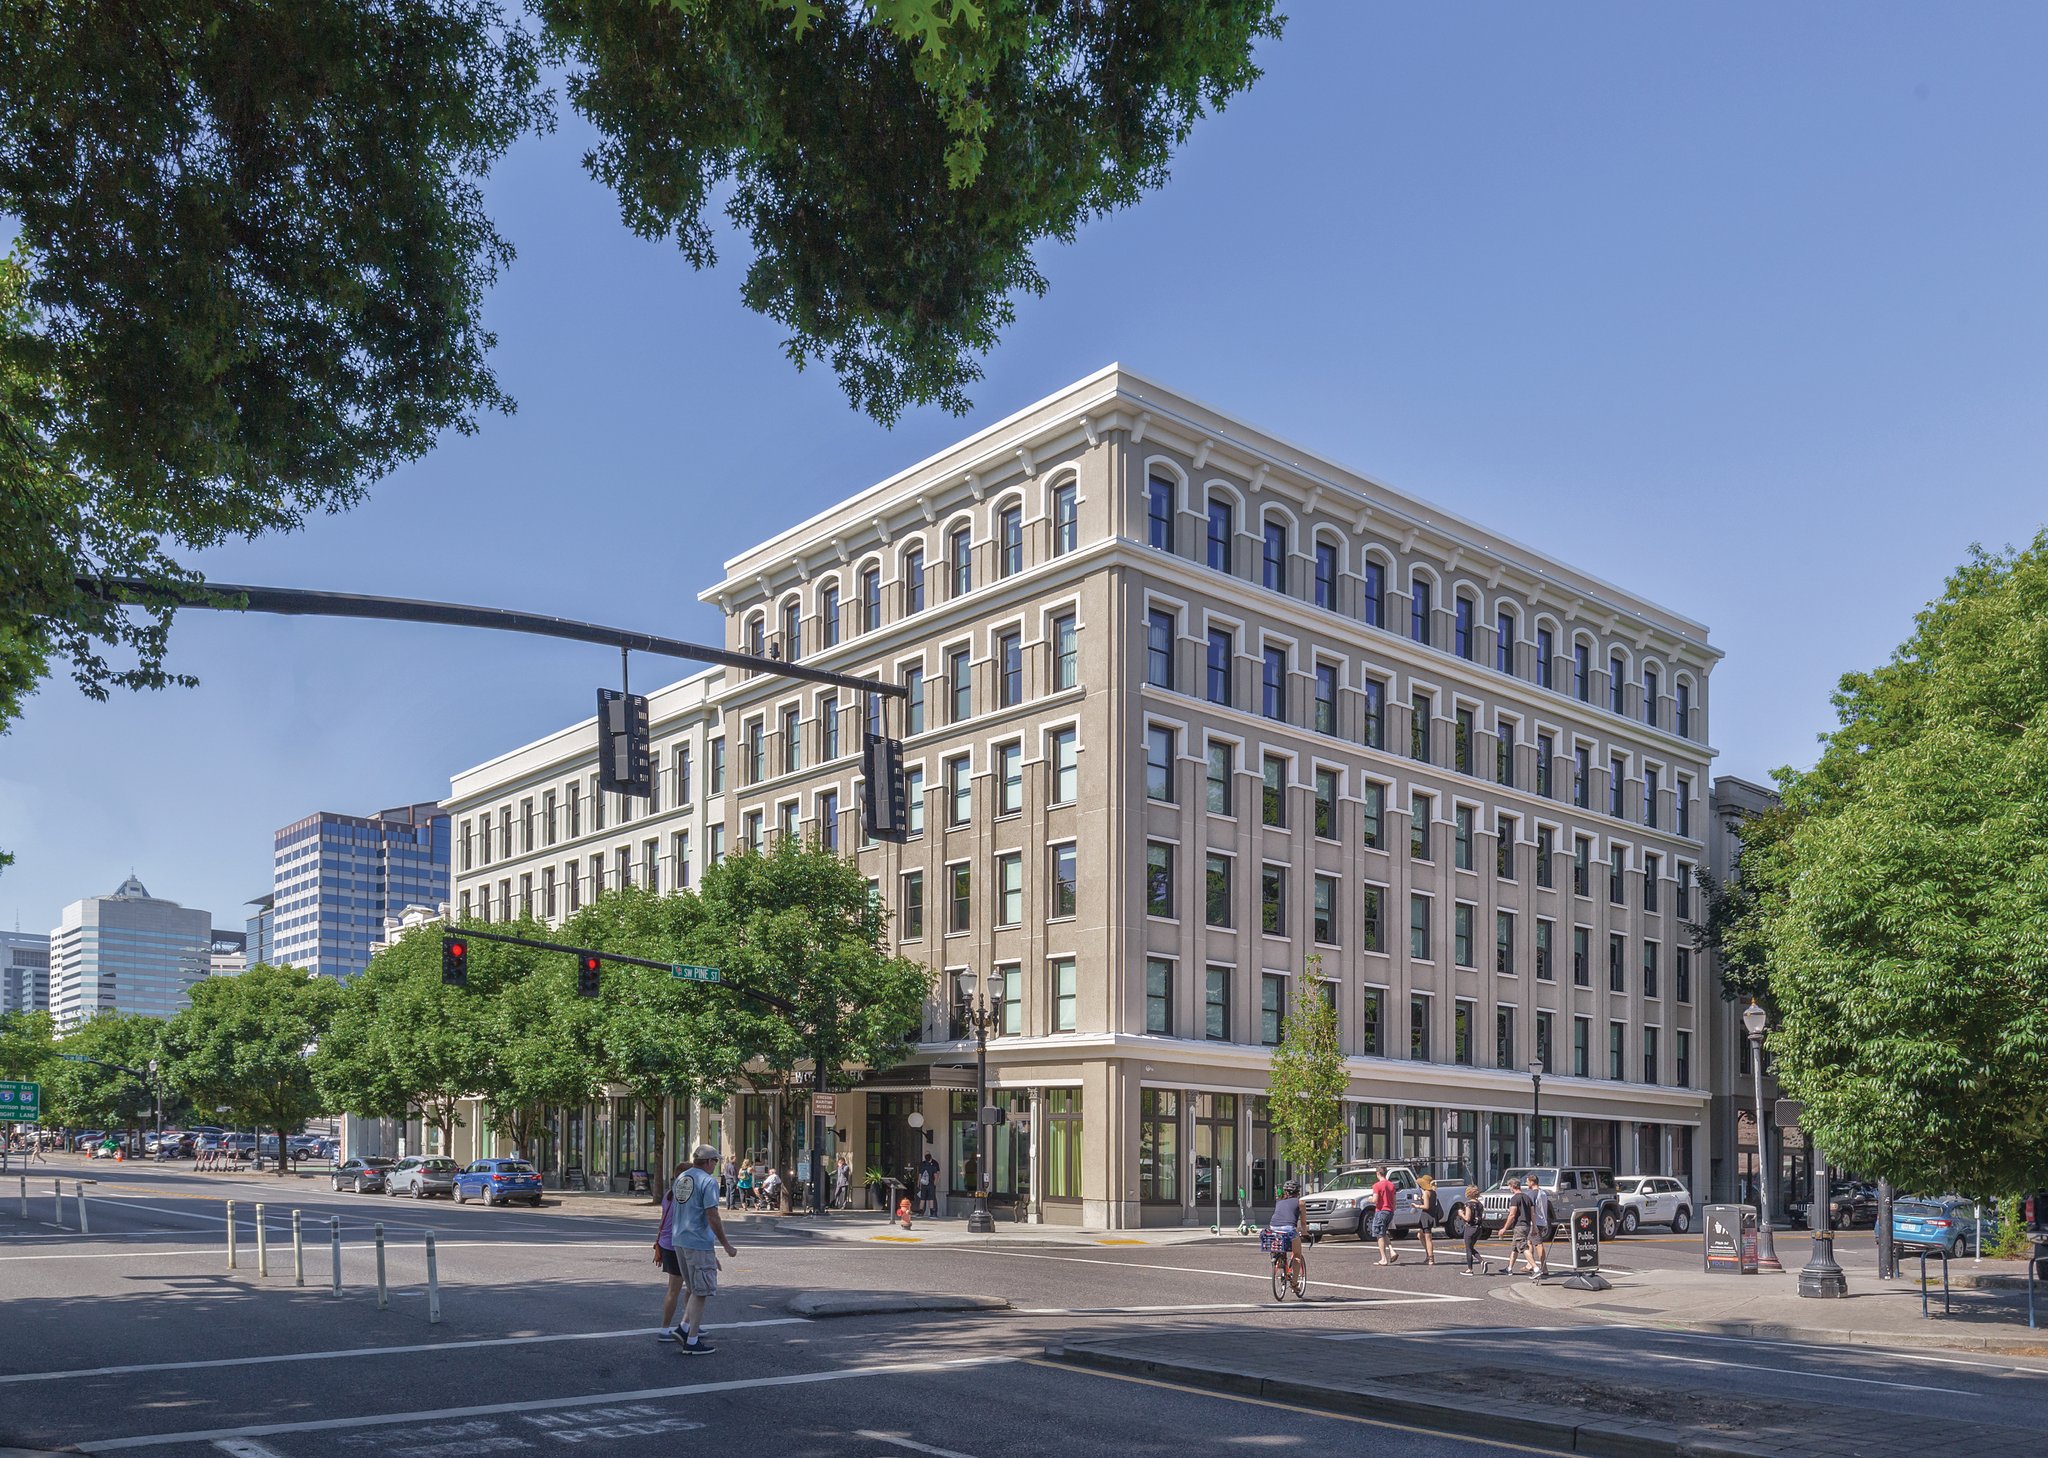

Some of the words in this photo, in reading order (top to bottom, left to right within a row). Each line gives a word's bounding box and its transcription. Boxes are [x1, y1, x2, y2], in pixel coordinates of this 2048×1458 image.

[684, 968, 693, 977] SW
[694, 968, 709, 980] PINE
[711, 971, 718, 981] ST
[1578, 1231, 1594, 1240] Public
[1576, 1241, 1597, 1252] Parking
[521, 1404, 674, 1428] HERE
[549, 1418, 706, 1443] PEDS
